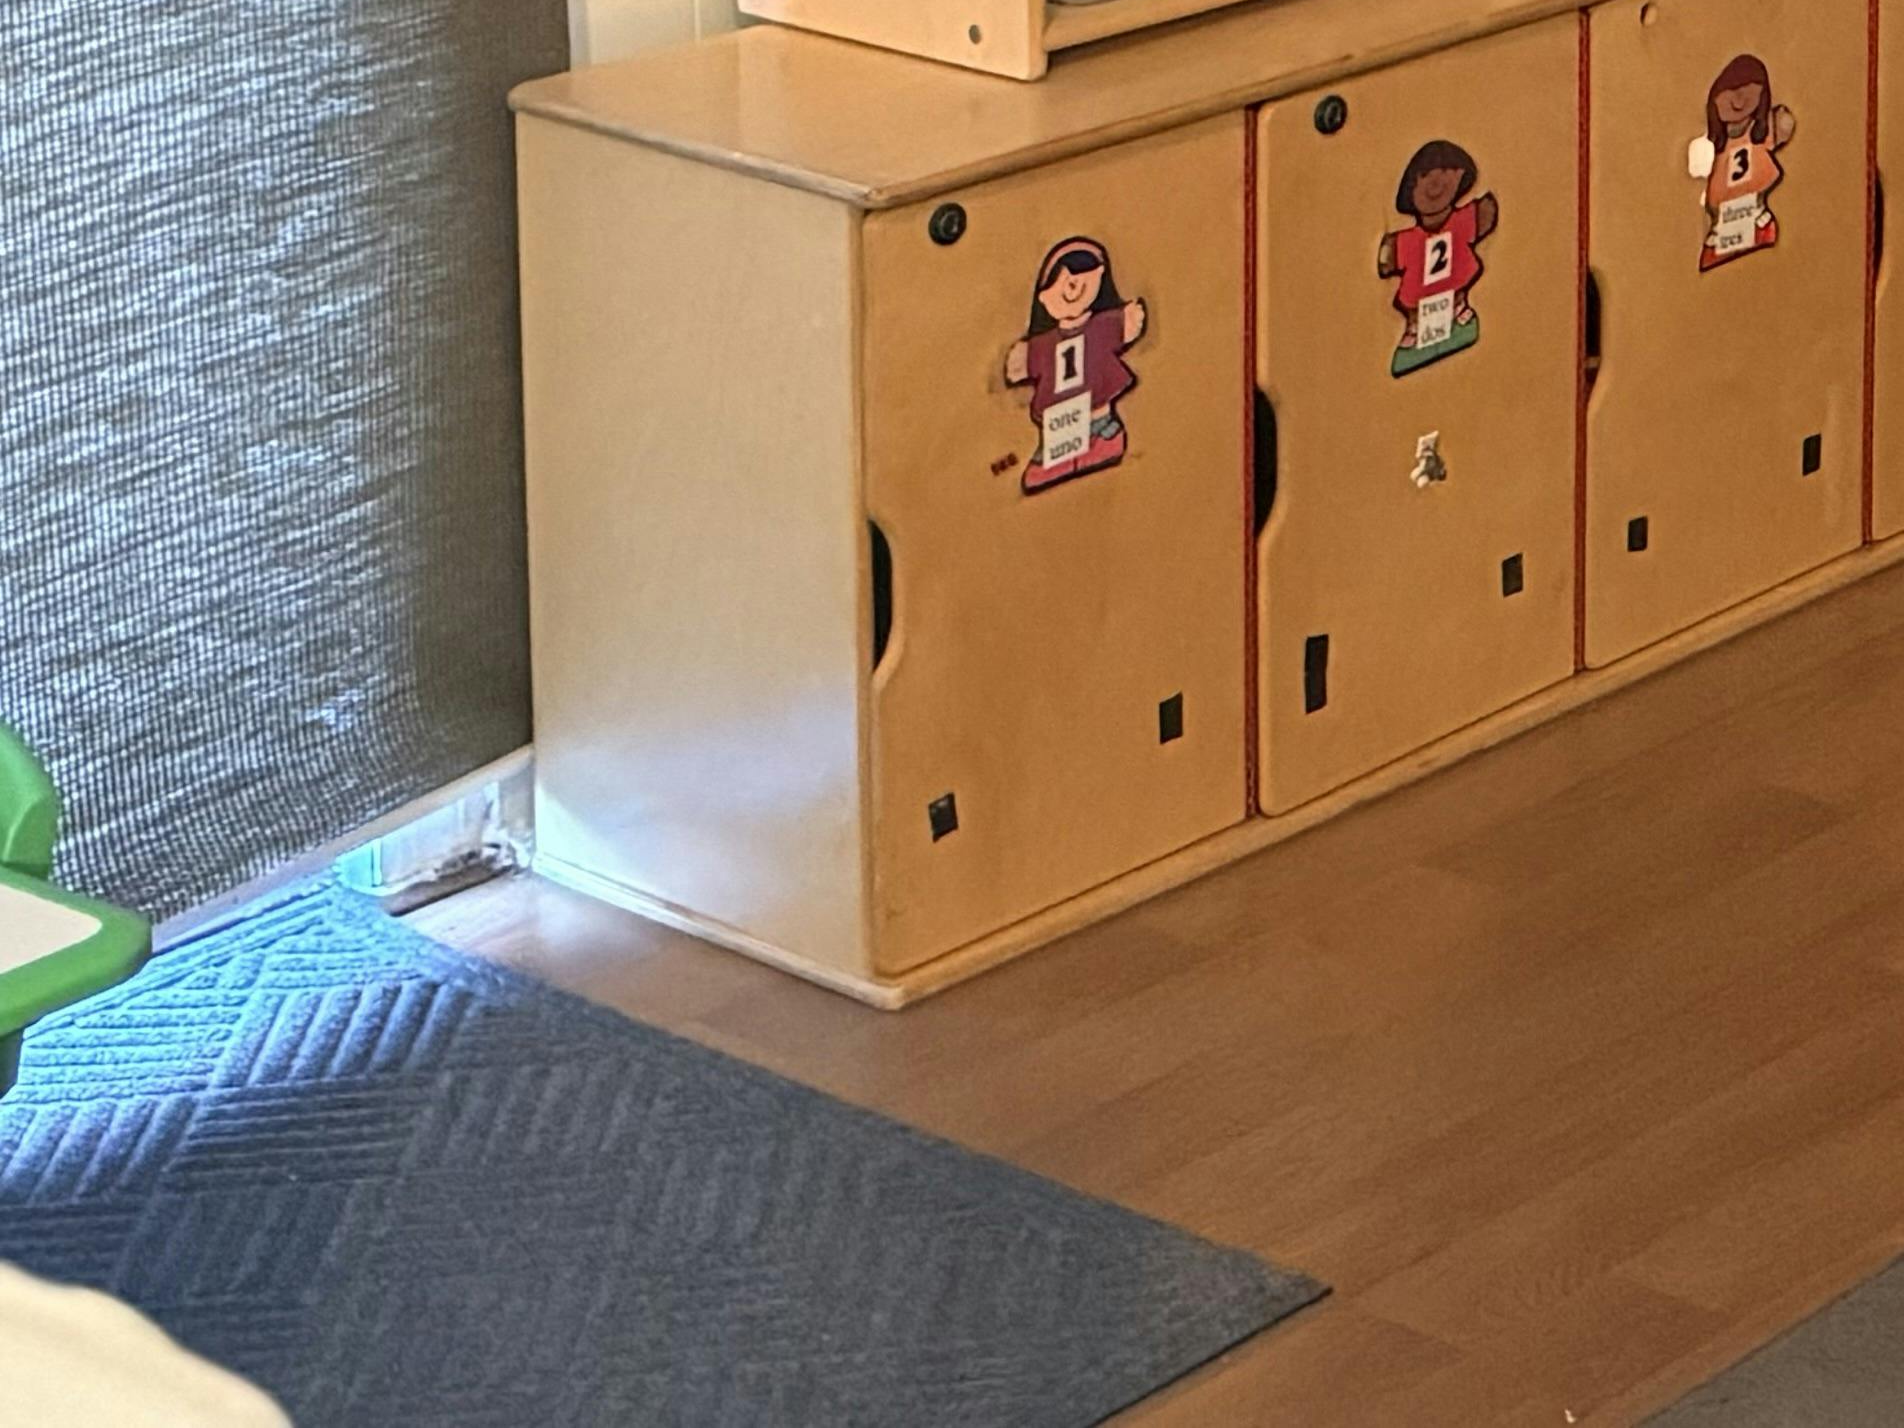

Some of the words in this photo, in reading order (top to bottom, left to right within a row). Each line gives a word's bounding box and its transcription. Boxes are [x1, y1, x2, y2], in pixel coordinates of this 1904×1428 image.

[1731, 148, 1749, 181] 3
[1430, 239, 1448, 275] 2
[1422, 297, 1449, 317] two
[1420, 324, 1447, 343] dos
[1061, 345, 1078, 381] 1
[1049, 408, 1081, 432] one
[1050, 437, 1083, 460] uno
